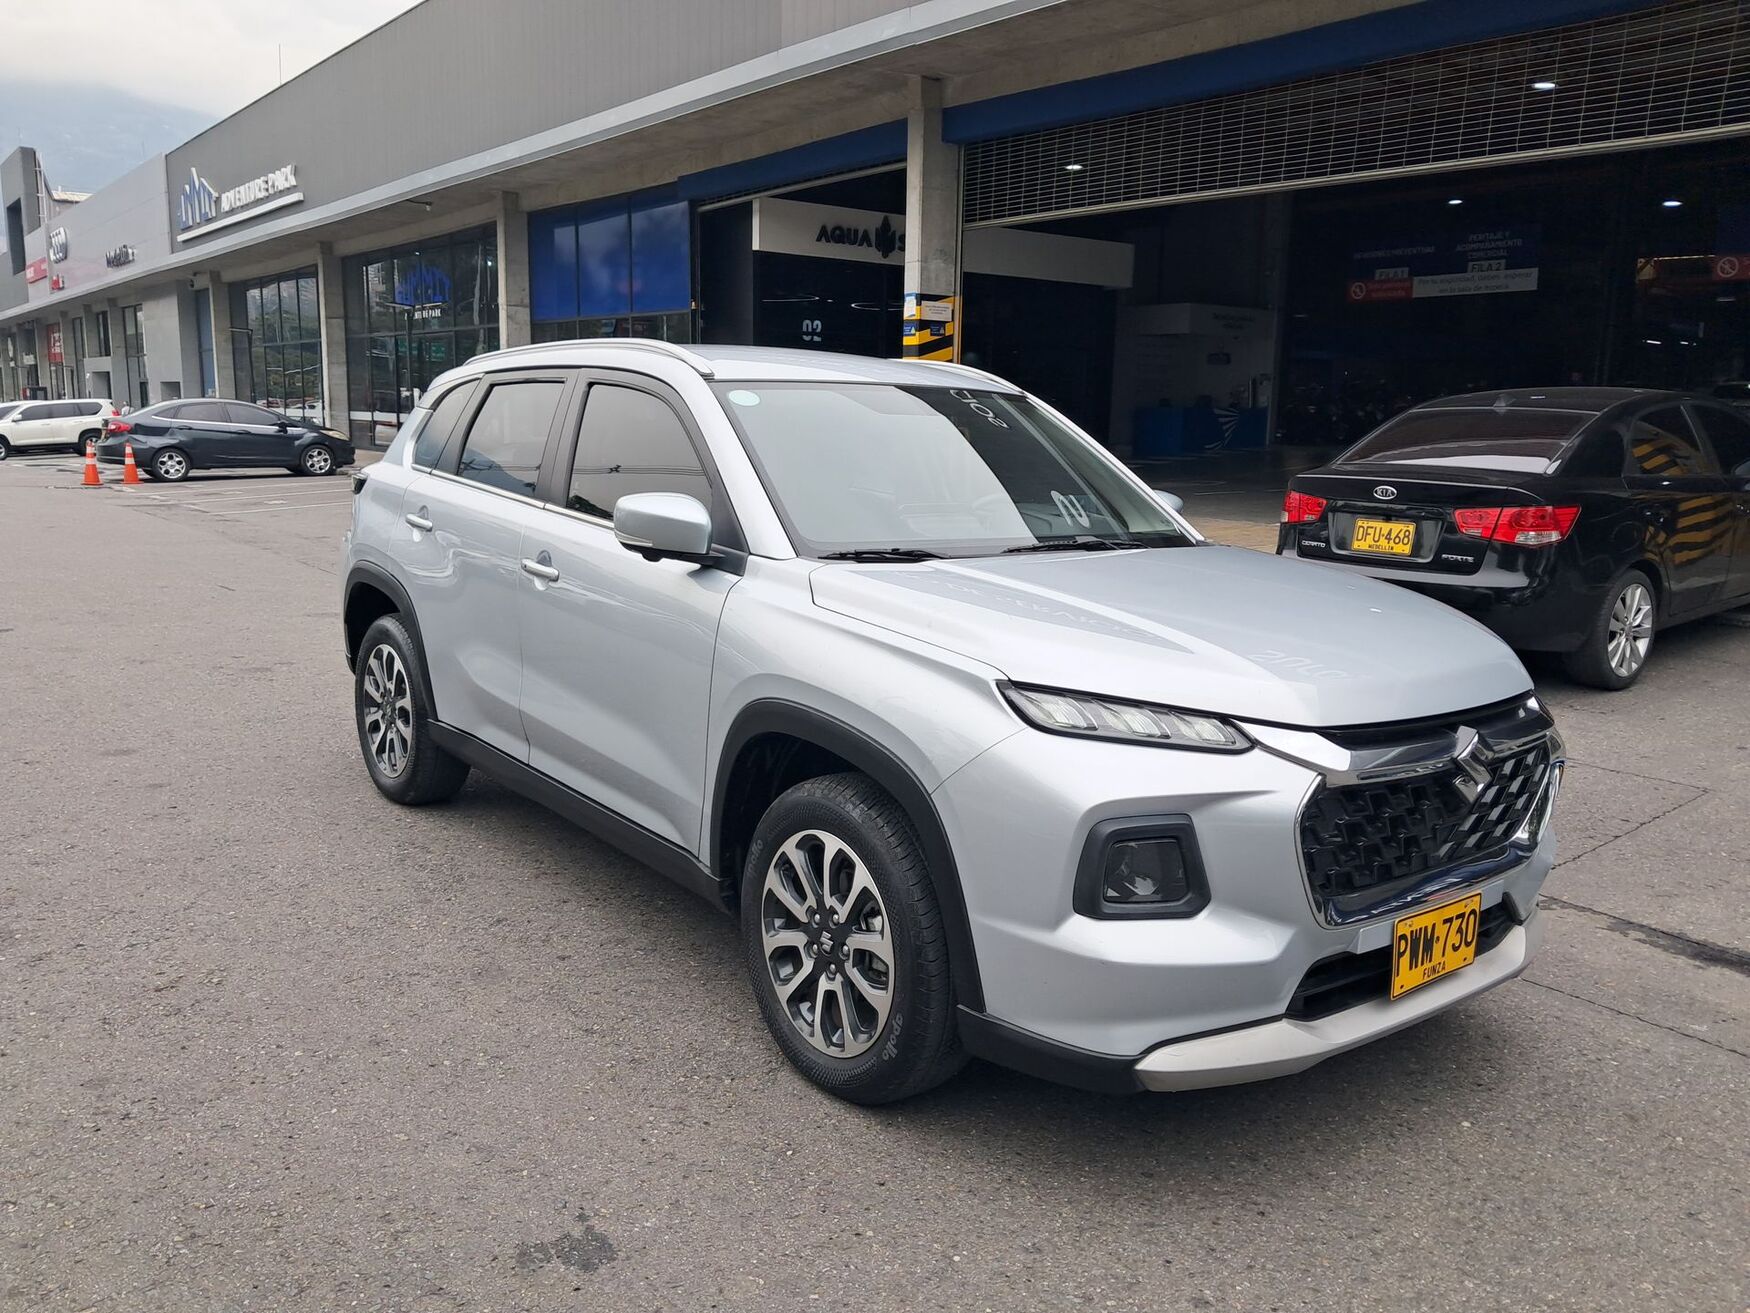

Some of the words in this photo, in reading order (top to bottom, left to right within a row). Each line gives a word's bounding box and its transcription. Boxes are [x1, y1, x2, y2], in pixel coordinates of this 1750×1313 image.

[221, 176, 268, 213] ADVENTURE
[267, 163, 297, 195] PARK
[816, 224, 873, 248] AQUA
[802, 319, 823, 342] 02
[1376, 486, 1394, 498] KIA
[1368, 543, 1394, 552] MEDELLIN
[1441, 554, 1475, 563] FORTE
[1422, 961, 1446, 981] FUNZA
